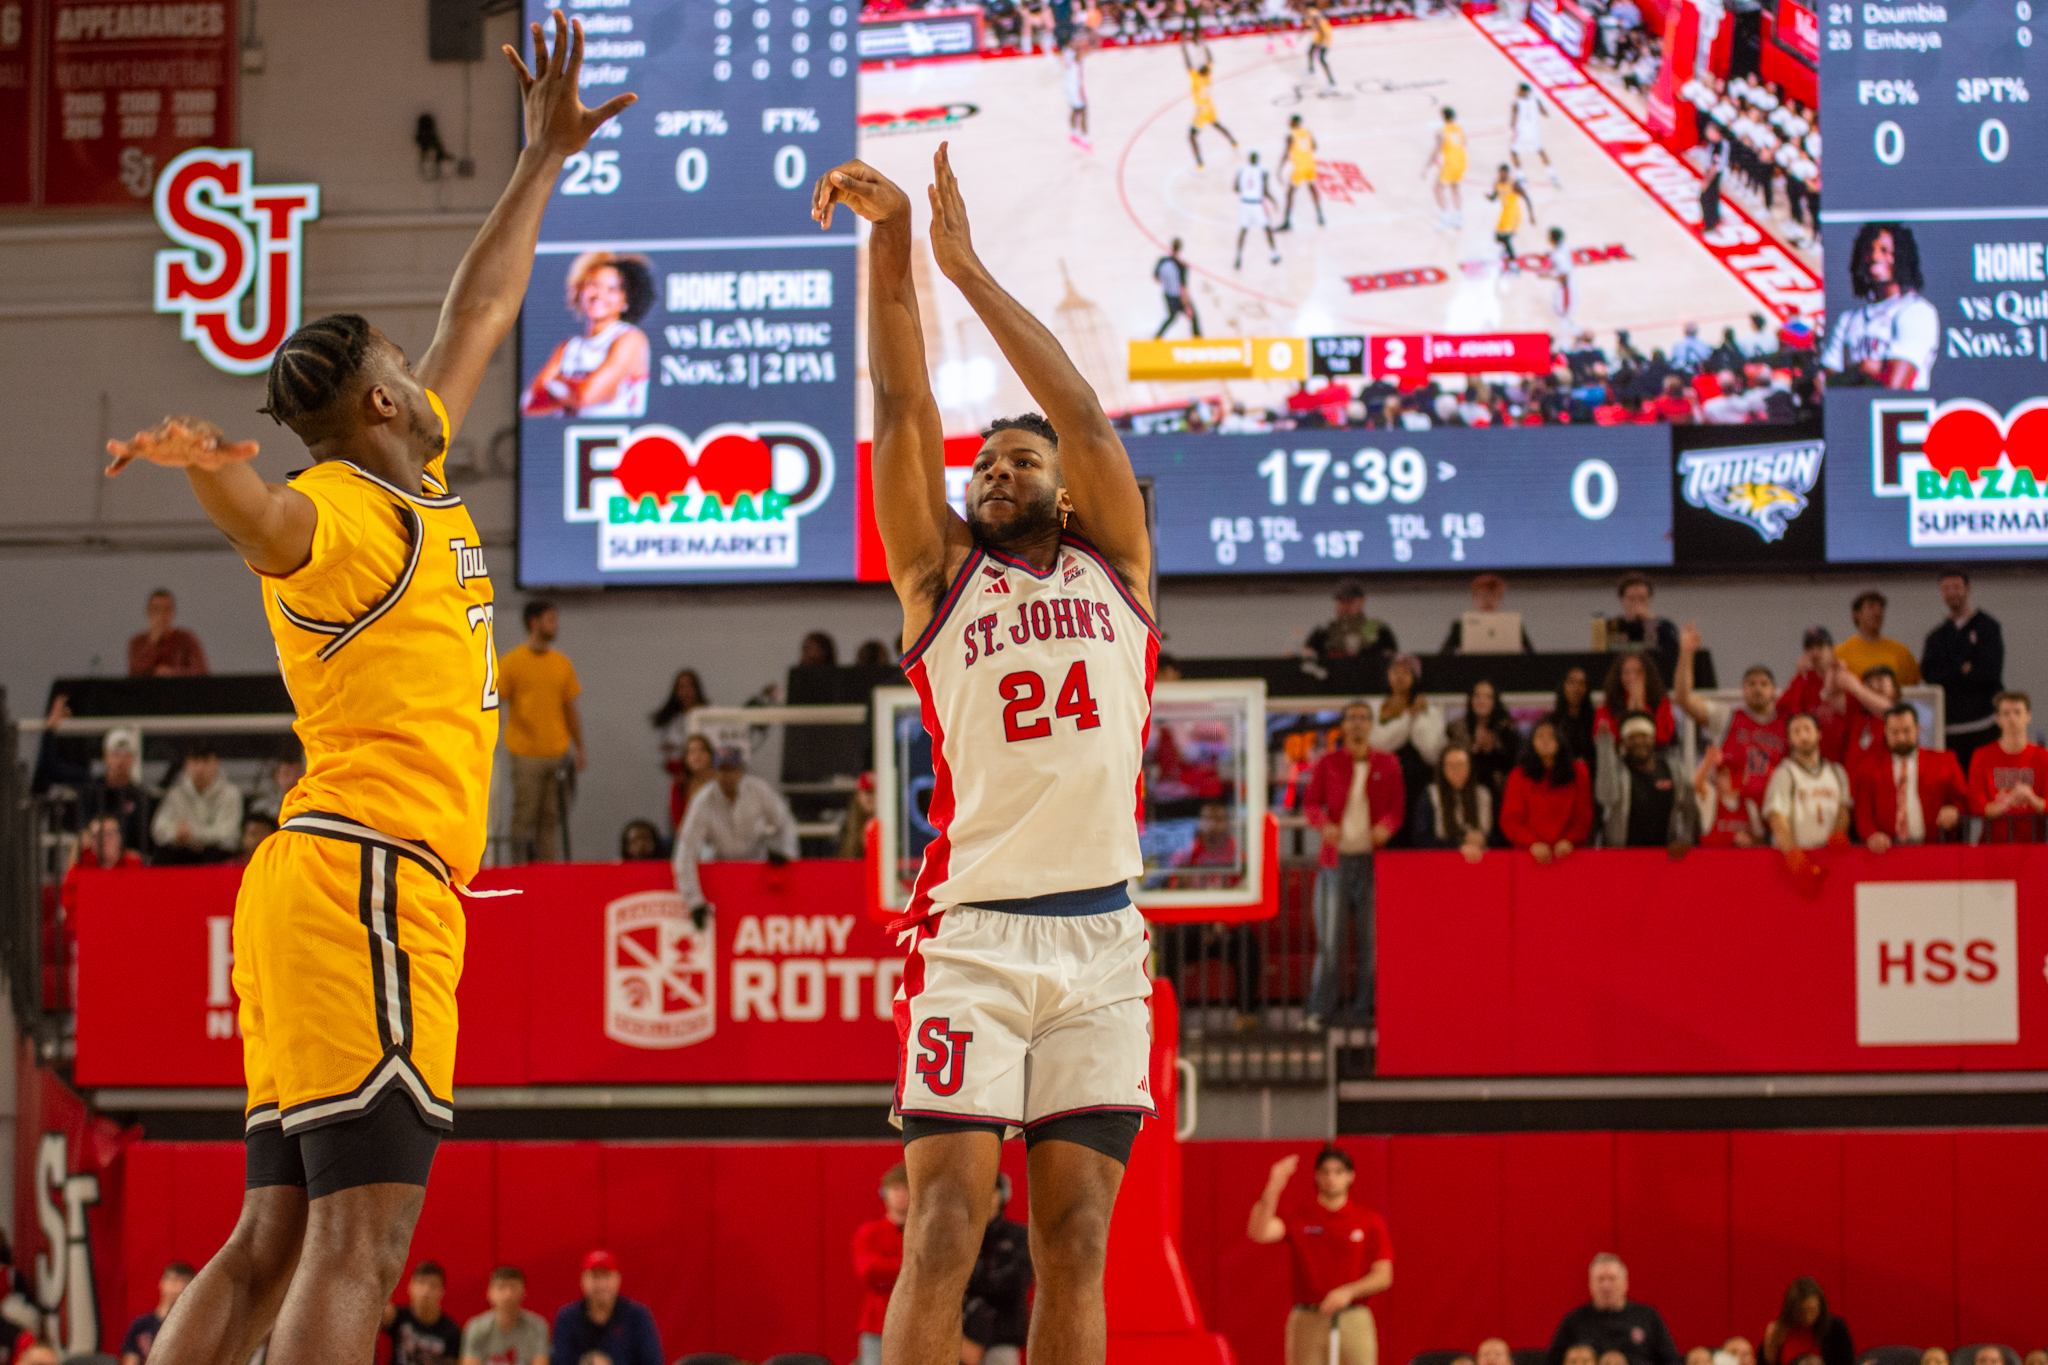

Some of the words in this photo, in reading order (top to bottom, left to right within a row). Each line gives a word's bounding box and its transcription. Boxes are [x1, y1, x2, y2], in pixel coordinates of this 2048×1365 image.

[57, 4, 224, 41] APPEARANCES
[715, 8, 732, 29] 0
[753, 8, 770, 29] 0
[792, 7, 809, 28] 0
[830, 6, 847, 27] 0
[1829, 4, 1852, 24] 21
[1864, 3, 1947, 24] Doumbia
[2016, 1, 2032, 21] 0
[715, 35, 731, 56] 2
[756, 35, 769, 53] 1
[792, 32, 809, 53] 0
[830, 31, 847, 52] 0
[1829, 29, 1853, 50] 23
[1864, 29, 1942, 52] Embeya
[2017, 26, 2032, 47] 0
[715, 60, 731, 81] 0
[753, 59, 769, 80] 0
[792, 58, 809, 79] 0
[830, 57, 847, 78] 0
[1859, 79, 1920, 105] FG%
[1957, 77, 2030, 103] 3PT%
[655, 110, 728, 136] 3PT%
[763, 108, 820, 133] FT%
[1874, 121, 1905, 165] 0
[1978, 118, 2010, 163] 0
[560, 151, 621, 195] 25
[676, 147, 708, 192] 0
[774, 145, 806, 189] 0
[1974, 243, 2046, 281] HOME
[667, 273, 737, 311] HOME
[738, 271, 833, 309] OPENER
[1960, 296, 1993, 321] vs
[665, 325, 699, 349] vs
[1268, 341, 1292, 371] 0
[1384, 338, 1407, 369] 2
[1259, 448, 1427, 504] 17:39
[1572, 460, 1618, 519] 0
[1685, 448, 1818, 501] TOWSON
[608, 490, 791, 524] BAZAAR
[1211, 516, 1254, 542] FLS
[1441, 513, 1485, 538] FLS
[609, 534, 788, 558] SUPERMARKET
[1314, 531, 1363, 558] 1ST
[1063, 565, 1079, 577] BIG
[964, 613, 1004, 670] ST.
[1009, 598, 1116, 645] JOHN'S
[999, 660, 1101, 743] 24
[732, 914, 856, 955] ARMY
[1878, 939, 1998, 986] HSS
